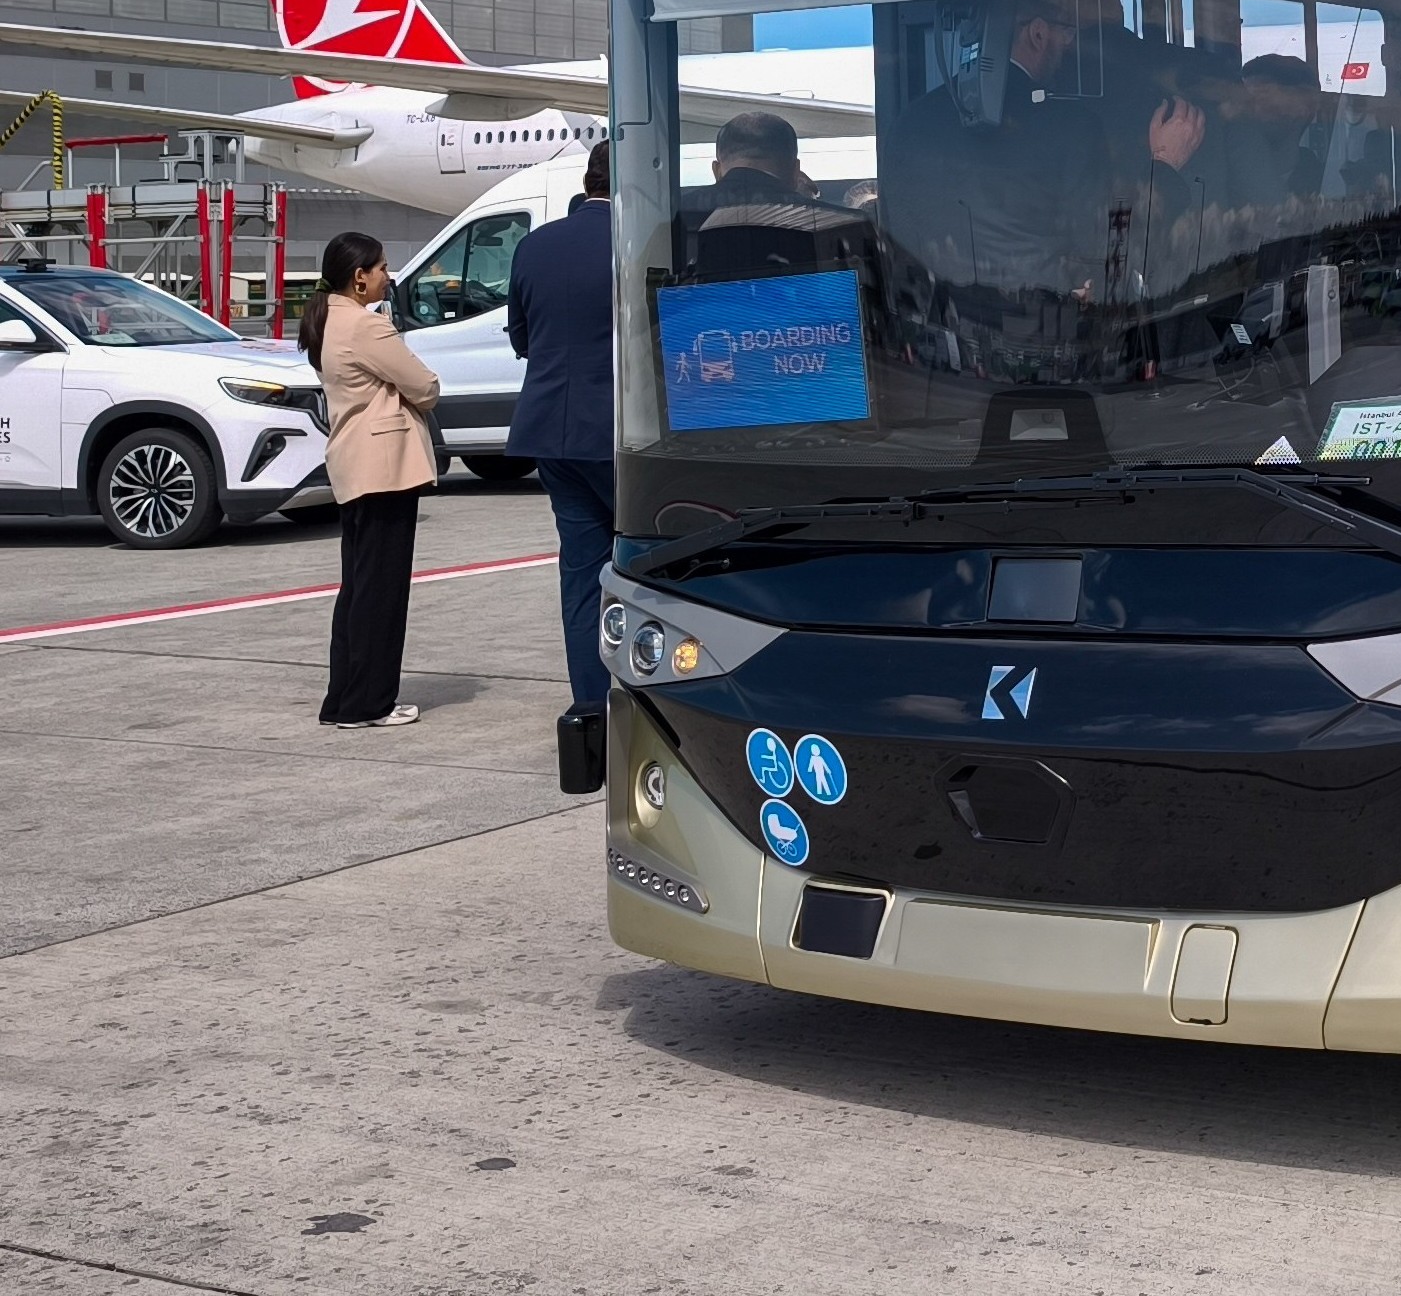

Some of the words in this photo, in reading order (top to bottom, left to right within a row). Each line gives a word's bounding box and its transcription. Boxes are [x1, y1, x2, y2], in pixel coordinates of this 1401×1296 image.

[740, 322, 851, 351] BOARDING
[773, 353, 826, 375] NOW
[1359, 411, 1395, 420] Istanbul
